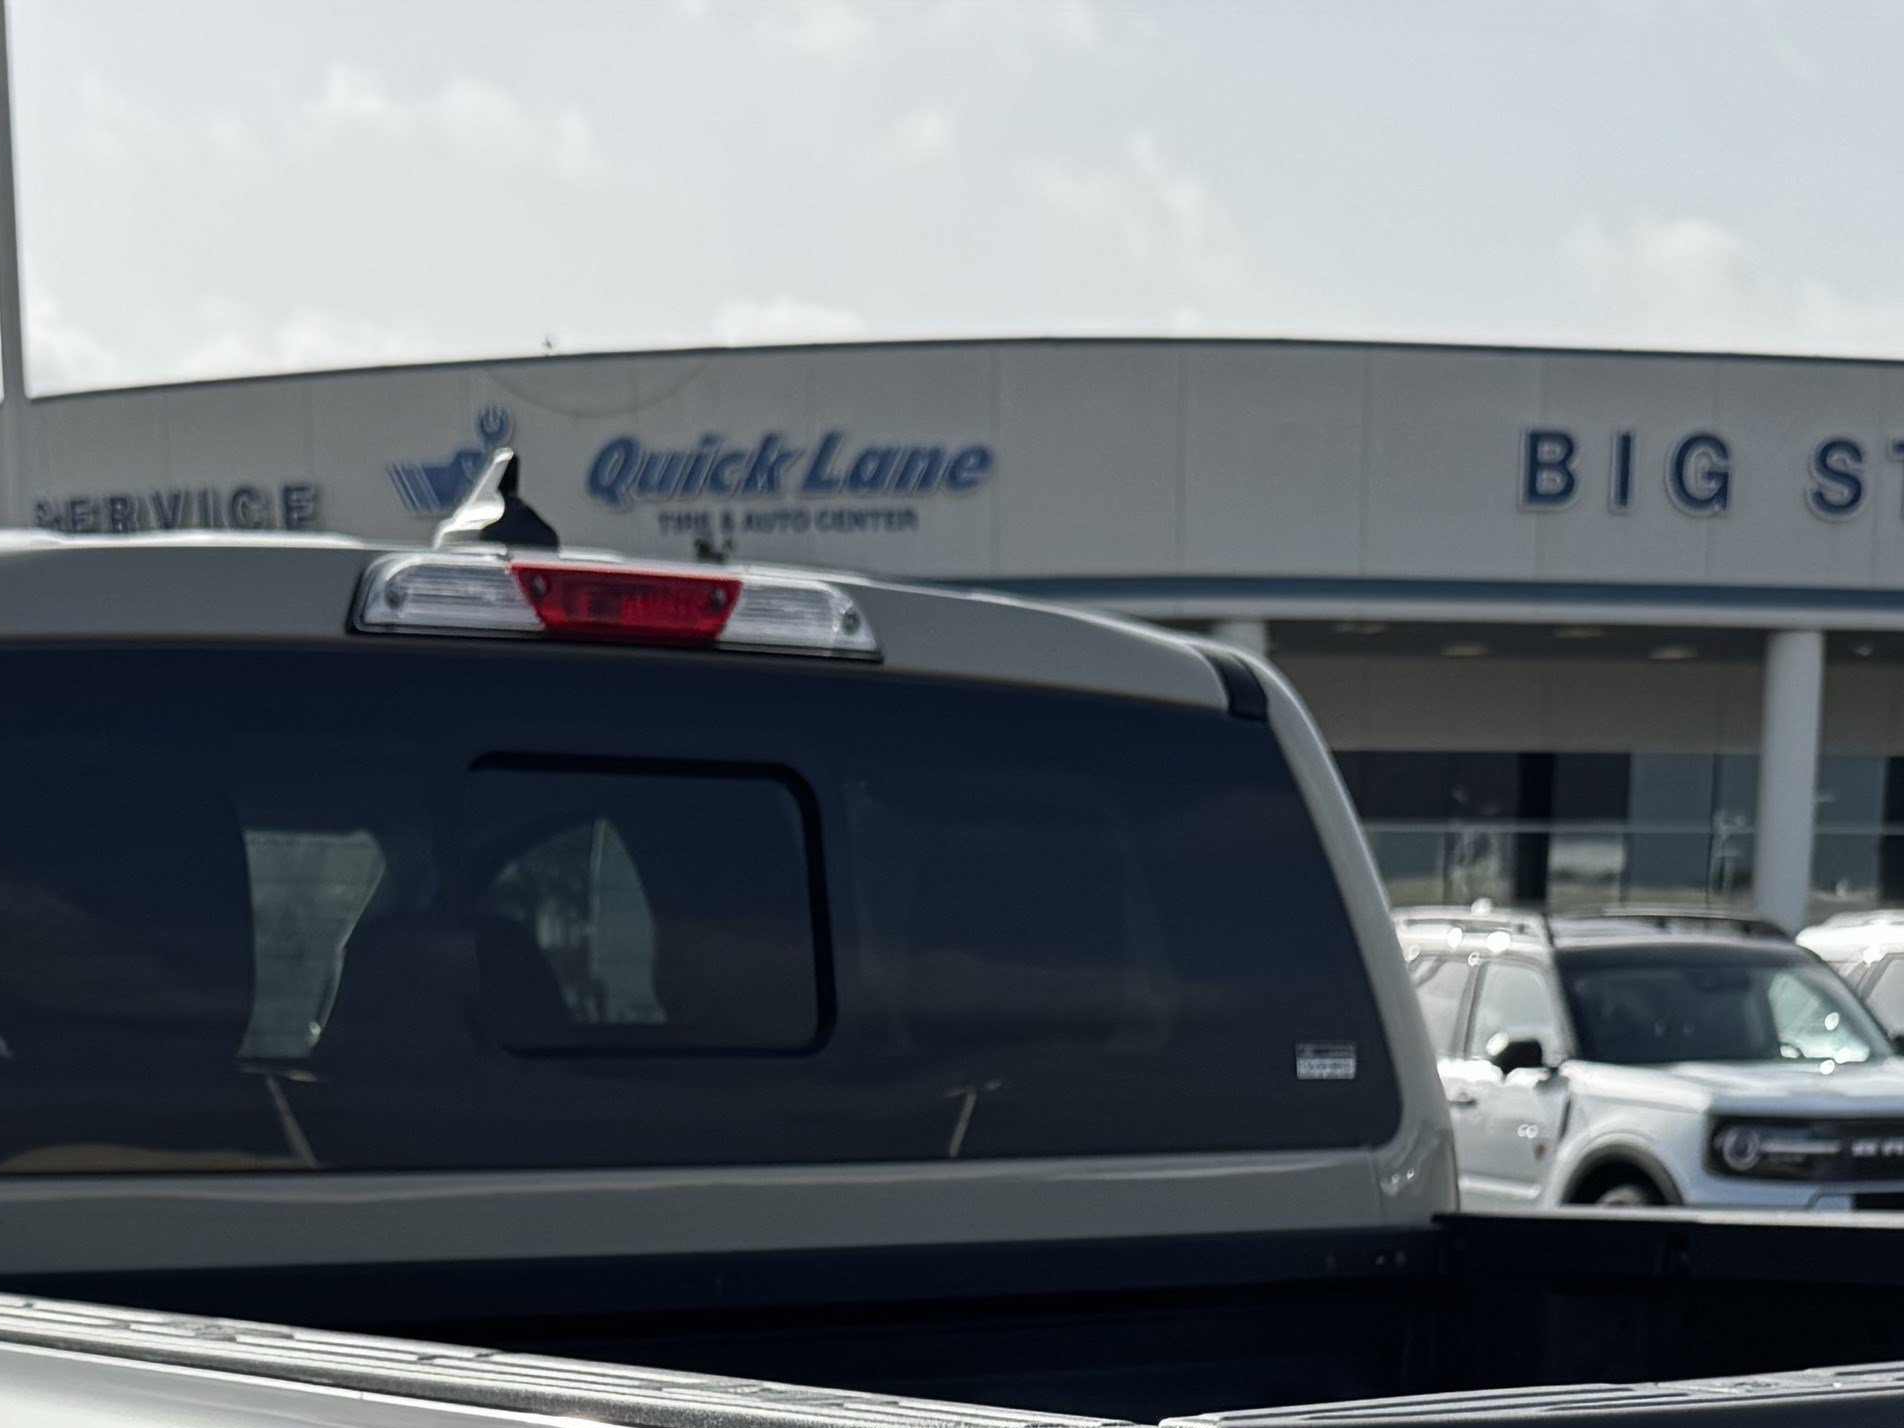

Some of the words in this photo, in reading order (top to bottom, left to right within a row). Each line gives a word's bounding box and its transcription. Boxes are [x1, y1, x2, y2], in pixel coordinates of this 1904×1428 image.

[587, 433, 796, 511] Quick
[800, 430, 994, 500] Lane
[1520, 429, 1730, 514] BIG
[33, 482, 319, 533] SERVICE
[744, 509, 811, 533] AUTO
[814, 508, 919, 533] CENTER
